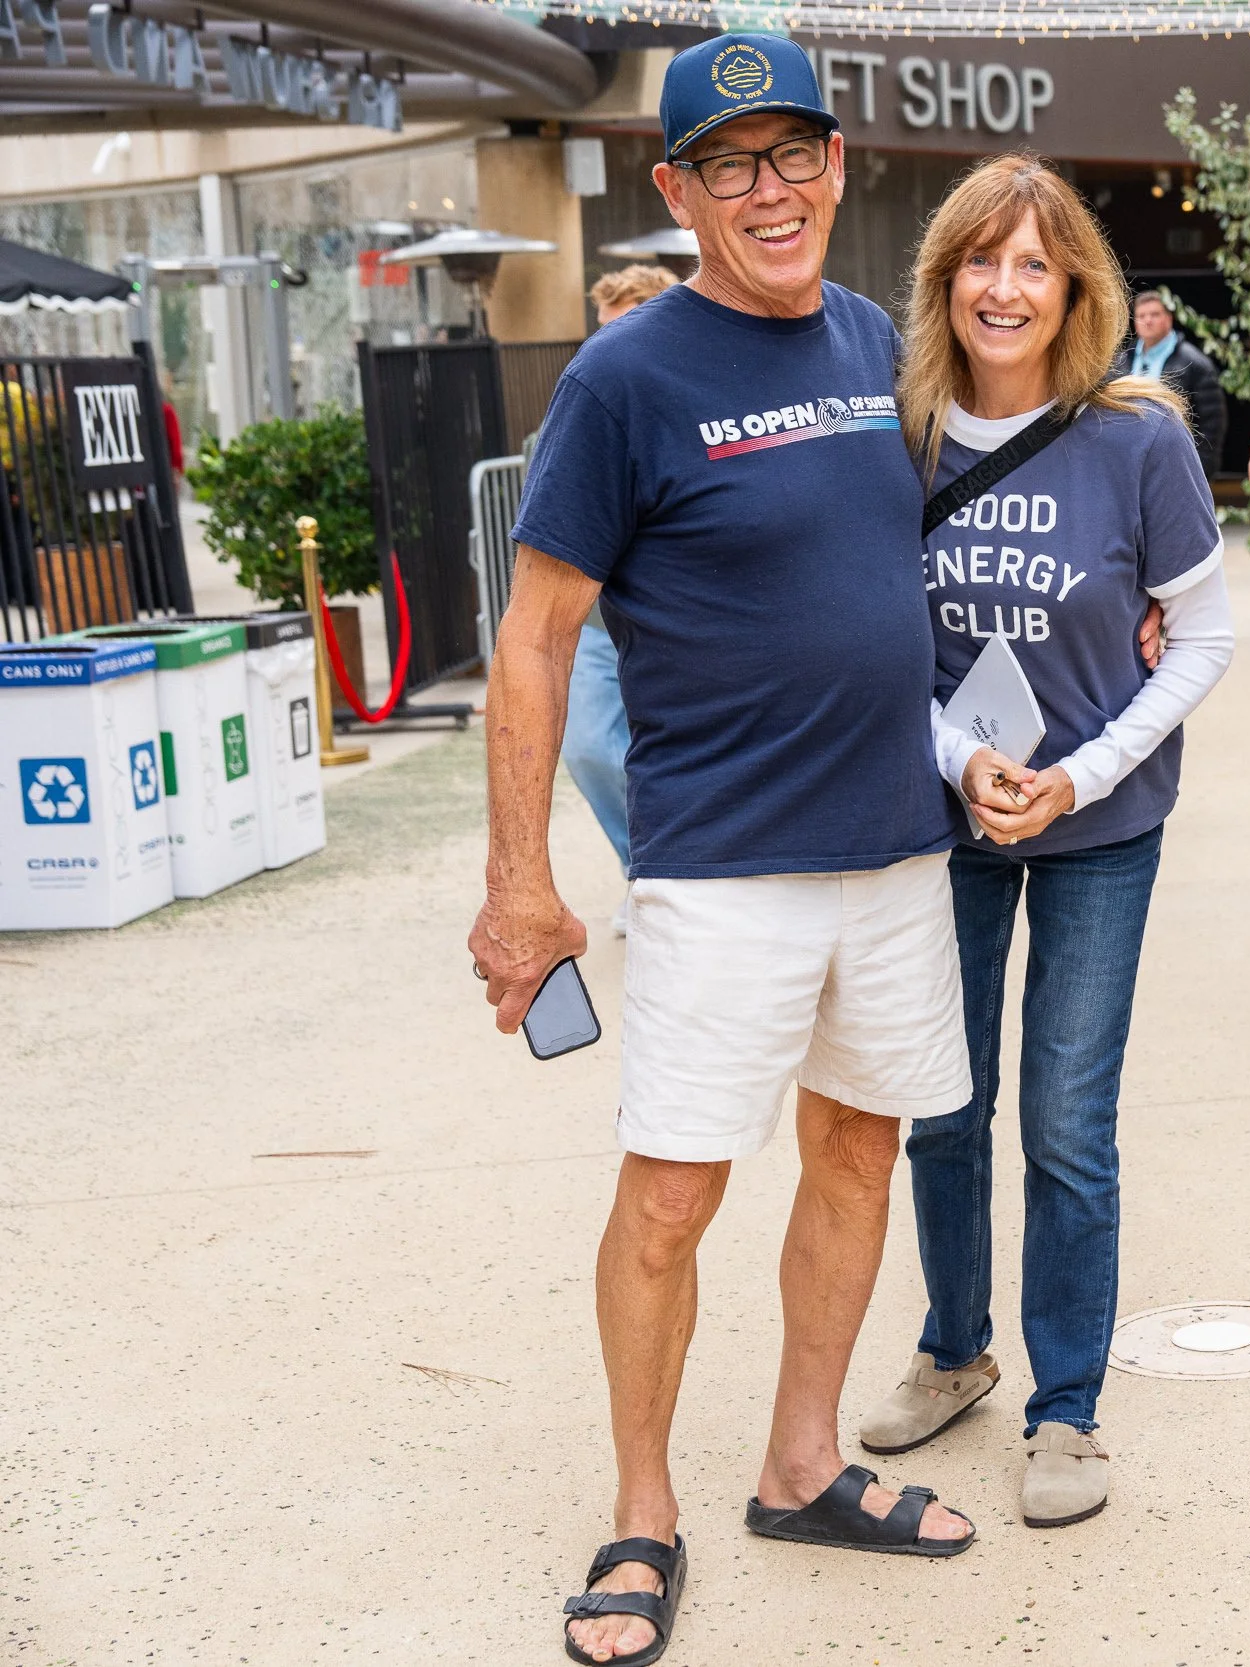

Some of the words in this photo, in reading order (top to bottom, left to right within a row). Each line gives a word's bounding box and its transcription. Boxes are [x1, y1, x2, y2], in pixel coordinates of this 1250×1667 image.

[714, 52, 727, 64] FILM
[725, 45, 737, 55] AND
[737, 44, 755, 54] MUSIC
[755, 50, 773, 72] FESTIVAL
[899, 56, 1054, 134] SHOP
[849, 396, 865, 410] OF
[74, 384, 145, 467] EXIT
[699, 419, 742, 446] US
[742, 402, 818, 437] OPEN
[951, 443, 1021, 505] BAGGU
[948, 493, 1057, 533] GOOD
[939, 602, 1050, 642] CLUB
[2, 665, 42, 679] CANS
[45, 664, 83, 678] ONLY
